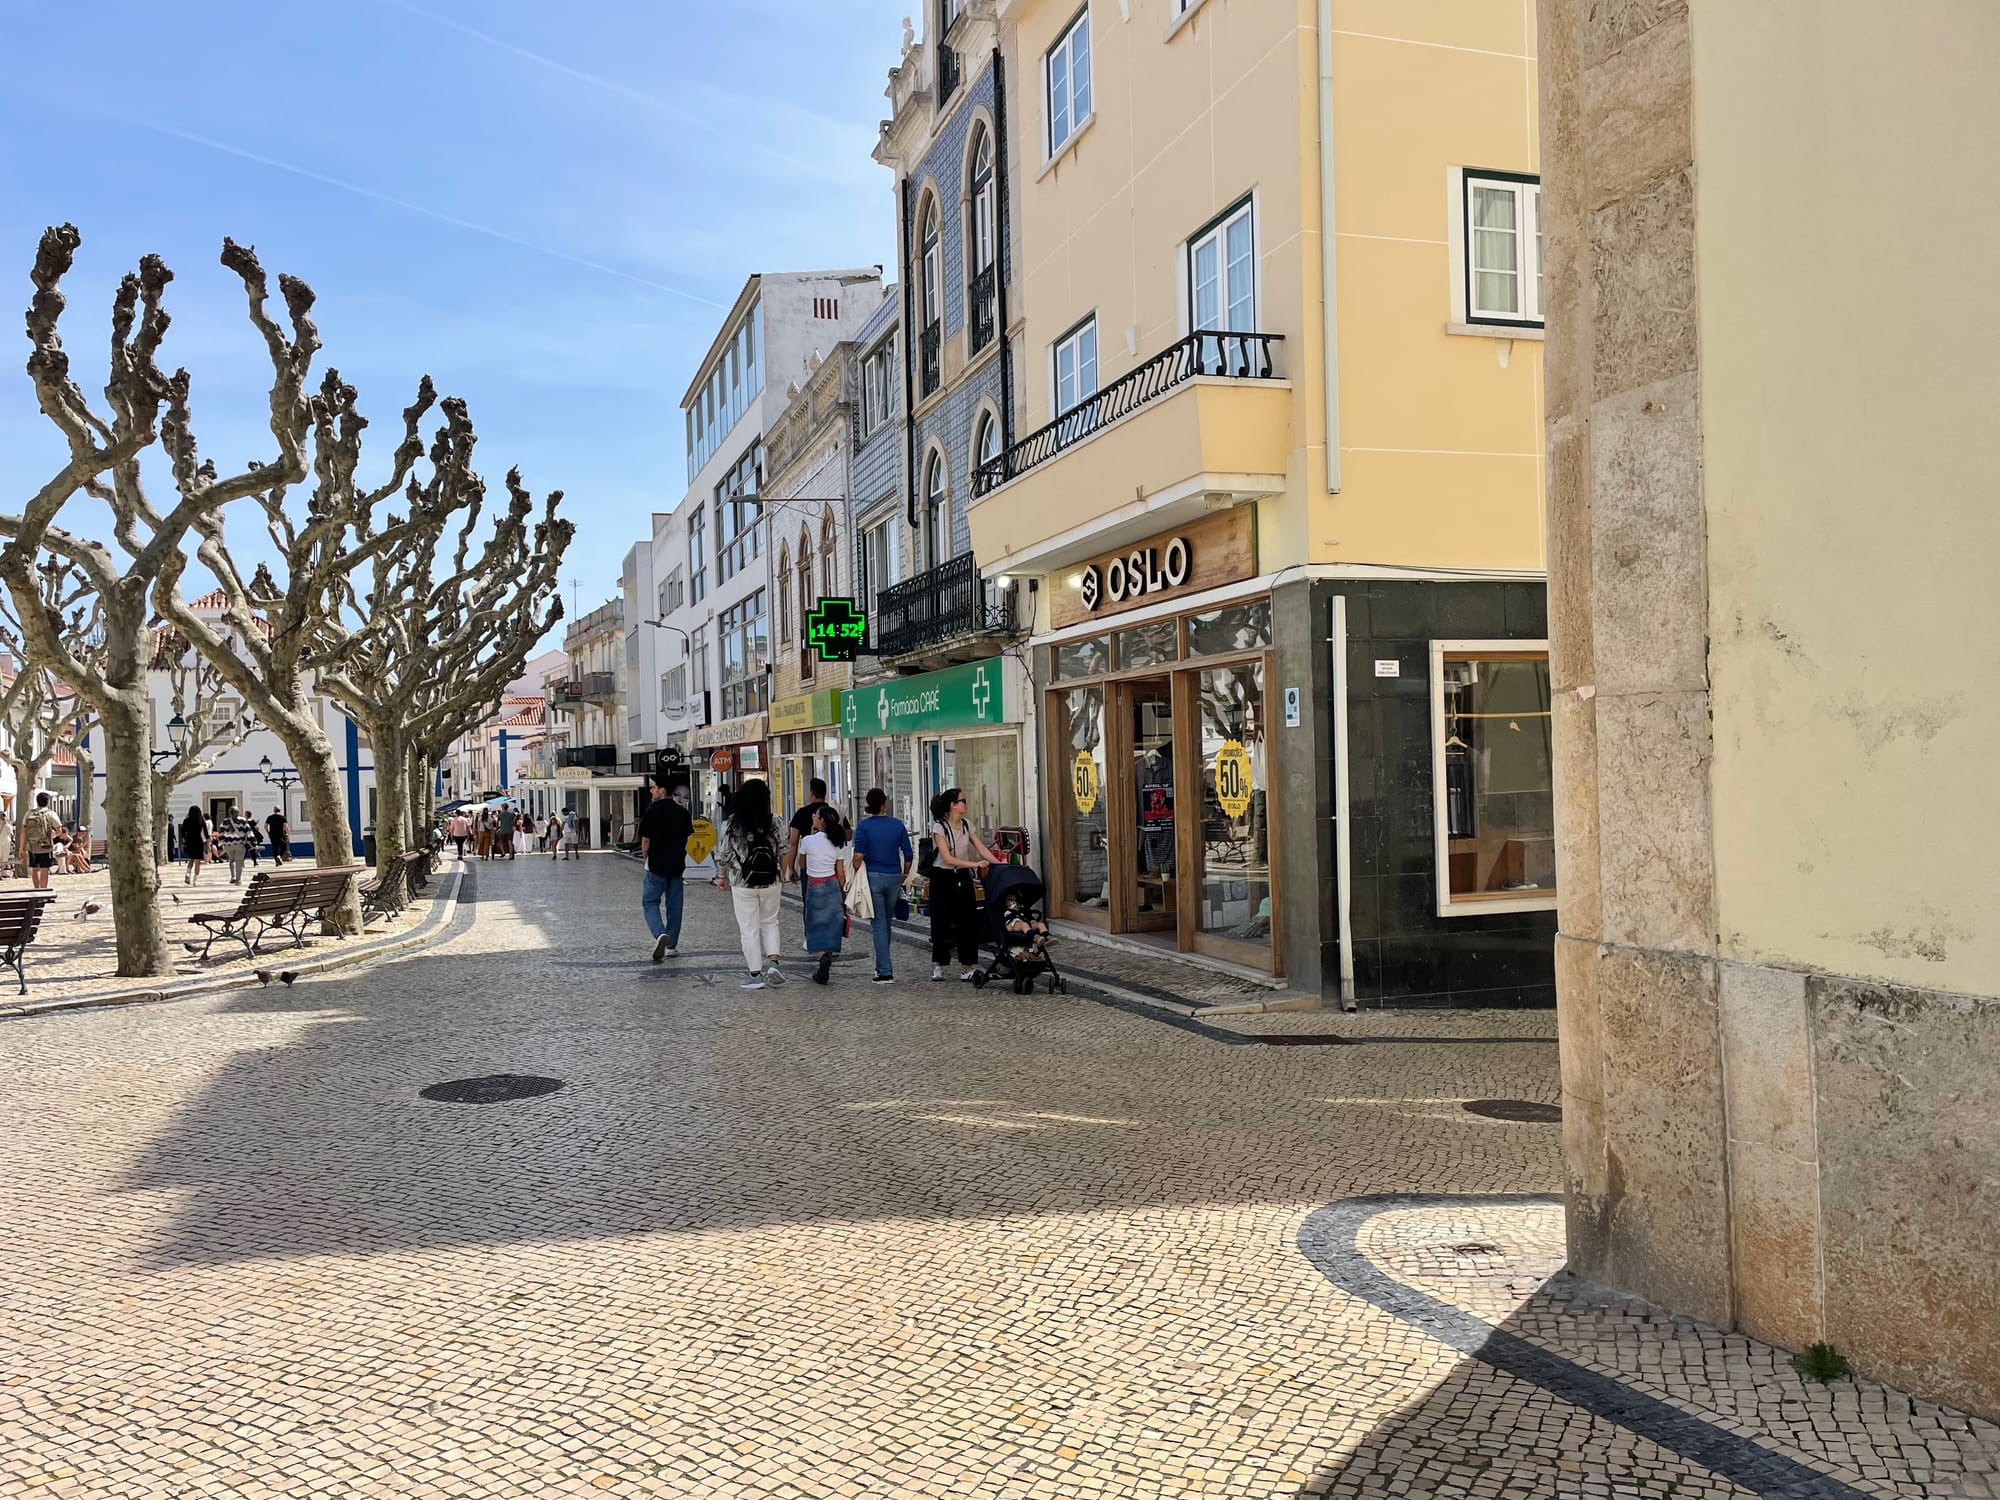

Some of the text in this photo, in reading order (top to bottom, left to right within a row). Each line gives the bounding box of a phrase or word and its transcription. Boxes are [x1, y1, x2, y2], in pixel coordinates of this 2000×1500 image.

[1107, 537, 1191, 602] OSLO
[816, 623, 859, 637] 14:52
[891, 696, 919, 717] Farmácia
[714, 756, 732, 765] ATM
[1076, 766, 1095, 798] 50%
[1220, 759, 1249, 798] 50%
